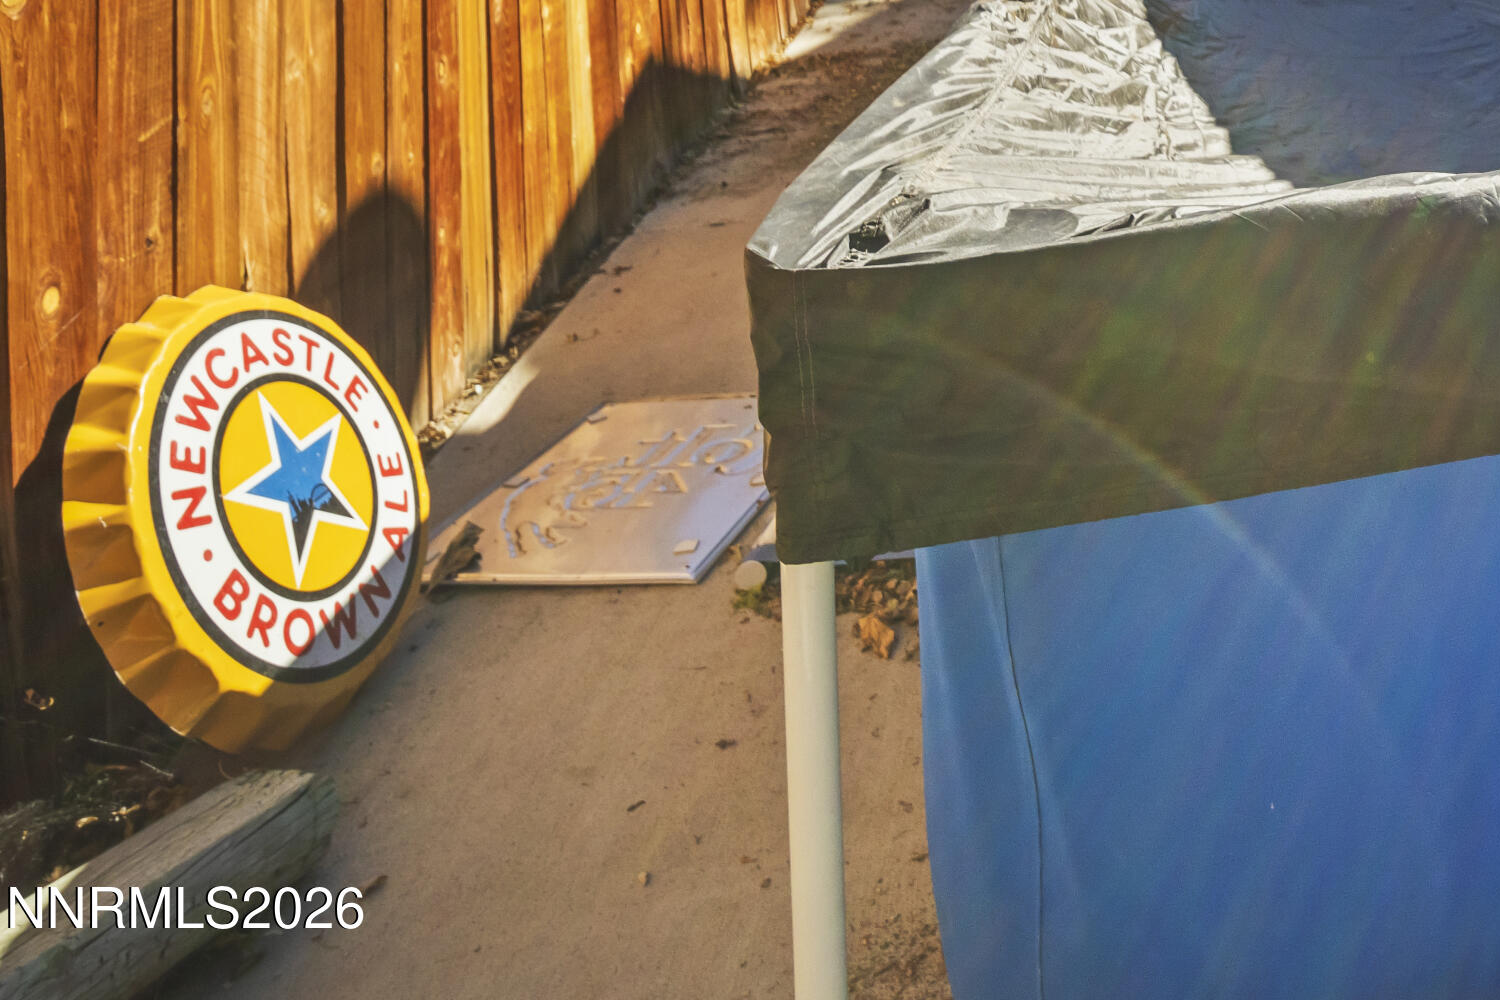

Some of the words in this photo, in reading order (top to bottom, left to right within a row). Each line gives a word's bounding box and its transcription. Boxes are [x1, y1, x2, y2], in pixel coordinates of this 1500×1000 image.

[170, 326, 370, 531] NEWCASTLE
[213, 566, 393, 658] BROWN
[376, 450, 410, 564] ALE
